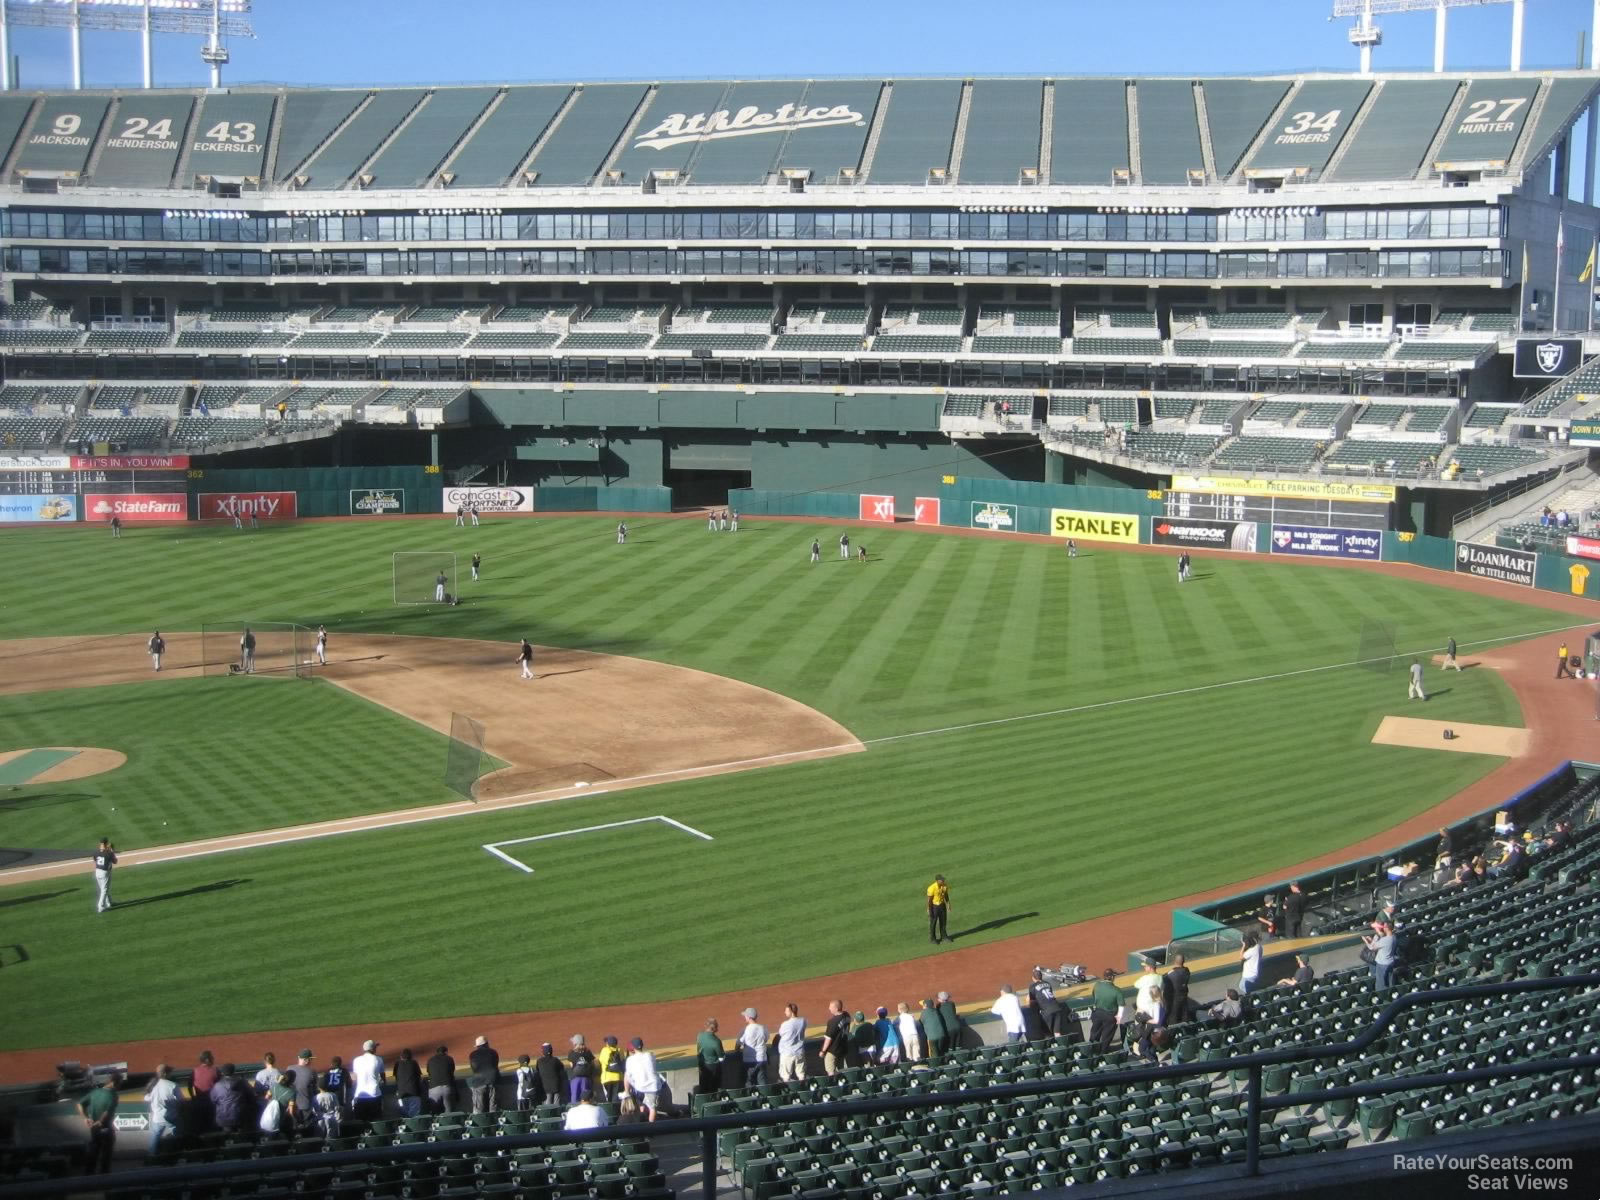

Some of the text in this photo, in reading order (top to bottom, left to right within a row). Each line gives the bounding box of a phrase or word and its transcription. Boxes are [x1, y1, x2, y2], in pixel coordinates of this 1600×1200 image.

[1462, 98, 1526, 122] 27
[53, 115, 81, 135] 9
[634, 103, 862, 149] Athletics
[1284, 110, 1341, 134] 34
[1458, 122, 1514, 134] HUNTER
[121, 118, 172, 139] 24
[206, 122, 256, 143] 43
[29, 135, 90, 146] JACKSON
[107, 138, 178, 150] HENDERSON
[1275, 133, 1330, 144] FINGERS
[193, 142, 262, 153] ECKERSLEY
[1572, 425, 1591, 435] DOWN
[77, 458, 87, 466] IF
[127, 458, 148, 467] YOU
[151, 459, 173, 467] WIN!
[187, 470, 204, 478] 362
[424, 465, 440, 473] 388
[942, 475, 955, 485] 388
[1147, 489, 1163, 500] 362
[1267, 483, 1287, 493] FREE
[1288, 484, 1320, 495] PARKING
[1323, 484, 1361, 497] TUESDAYS
[114, 501, 181, 513] StateFarm
[217, 495, 279, 517] xfinity
[1055, 515, 1133, 537] STANLEY
[1293, 531, 1308, 539] MLB
[1309, 532, 1338, 540] TONIGHT
[1345, 535, 1378, 548] xfinity
[1398, 531, 1415, 541] 367
[1307, 544, 1339, 552] NETWORK
[1470, 565, 1531, 584] CAR TITLE LOANS
[328, 1073, 342, 1086] 15
